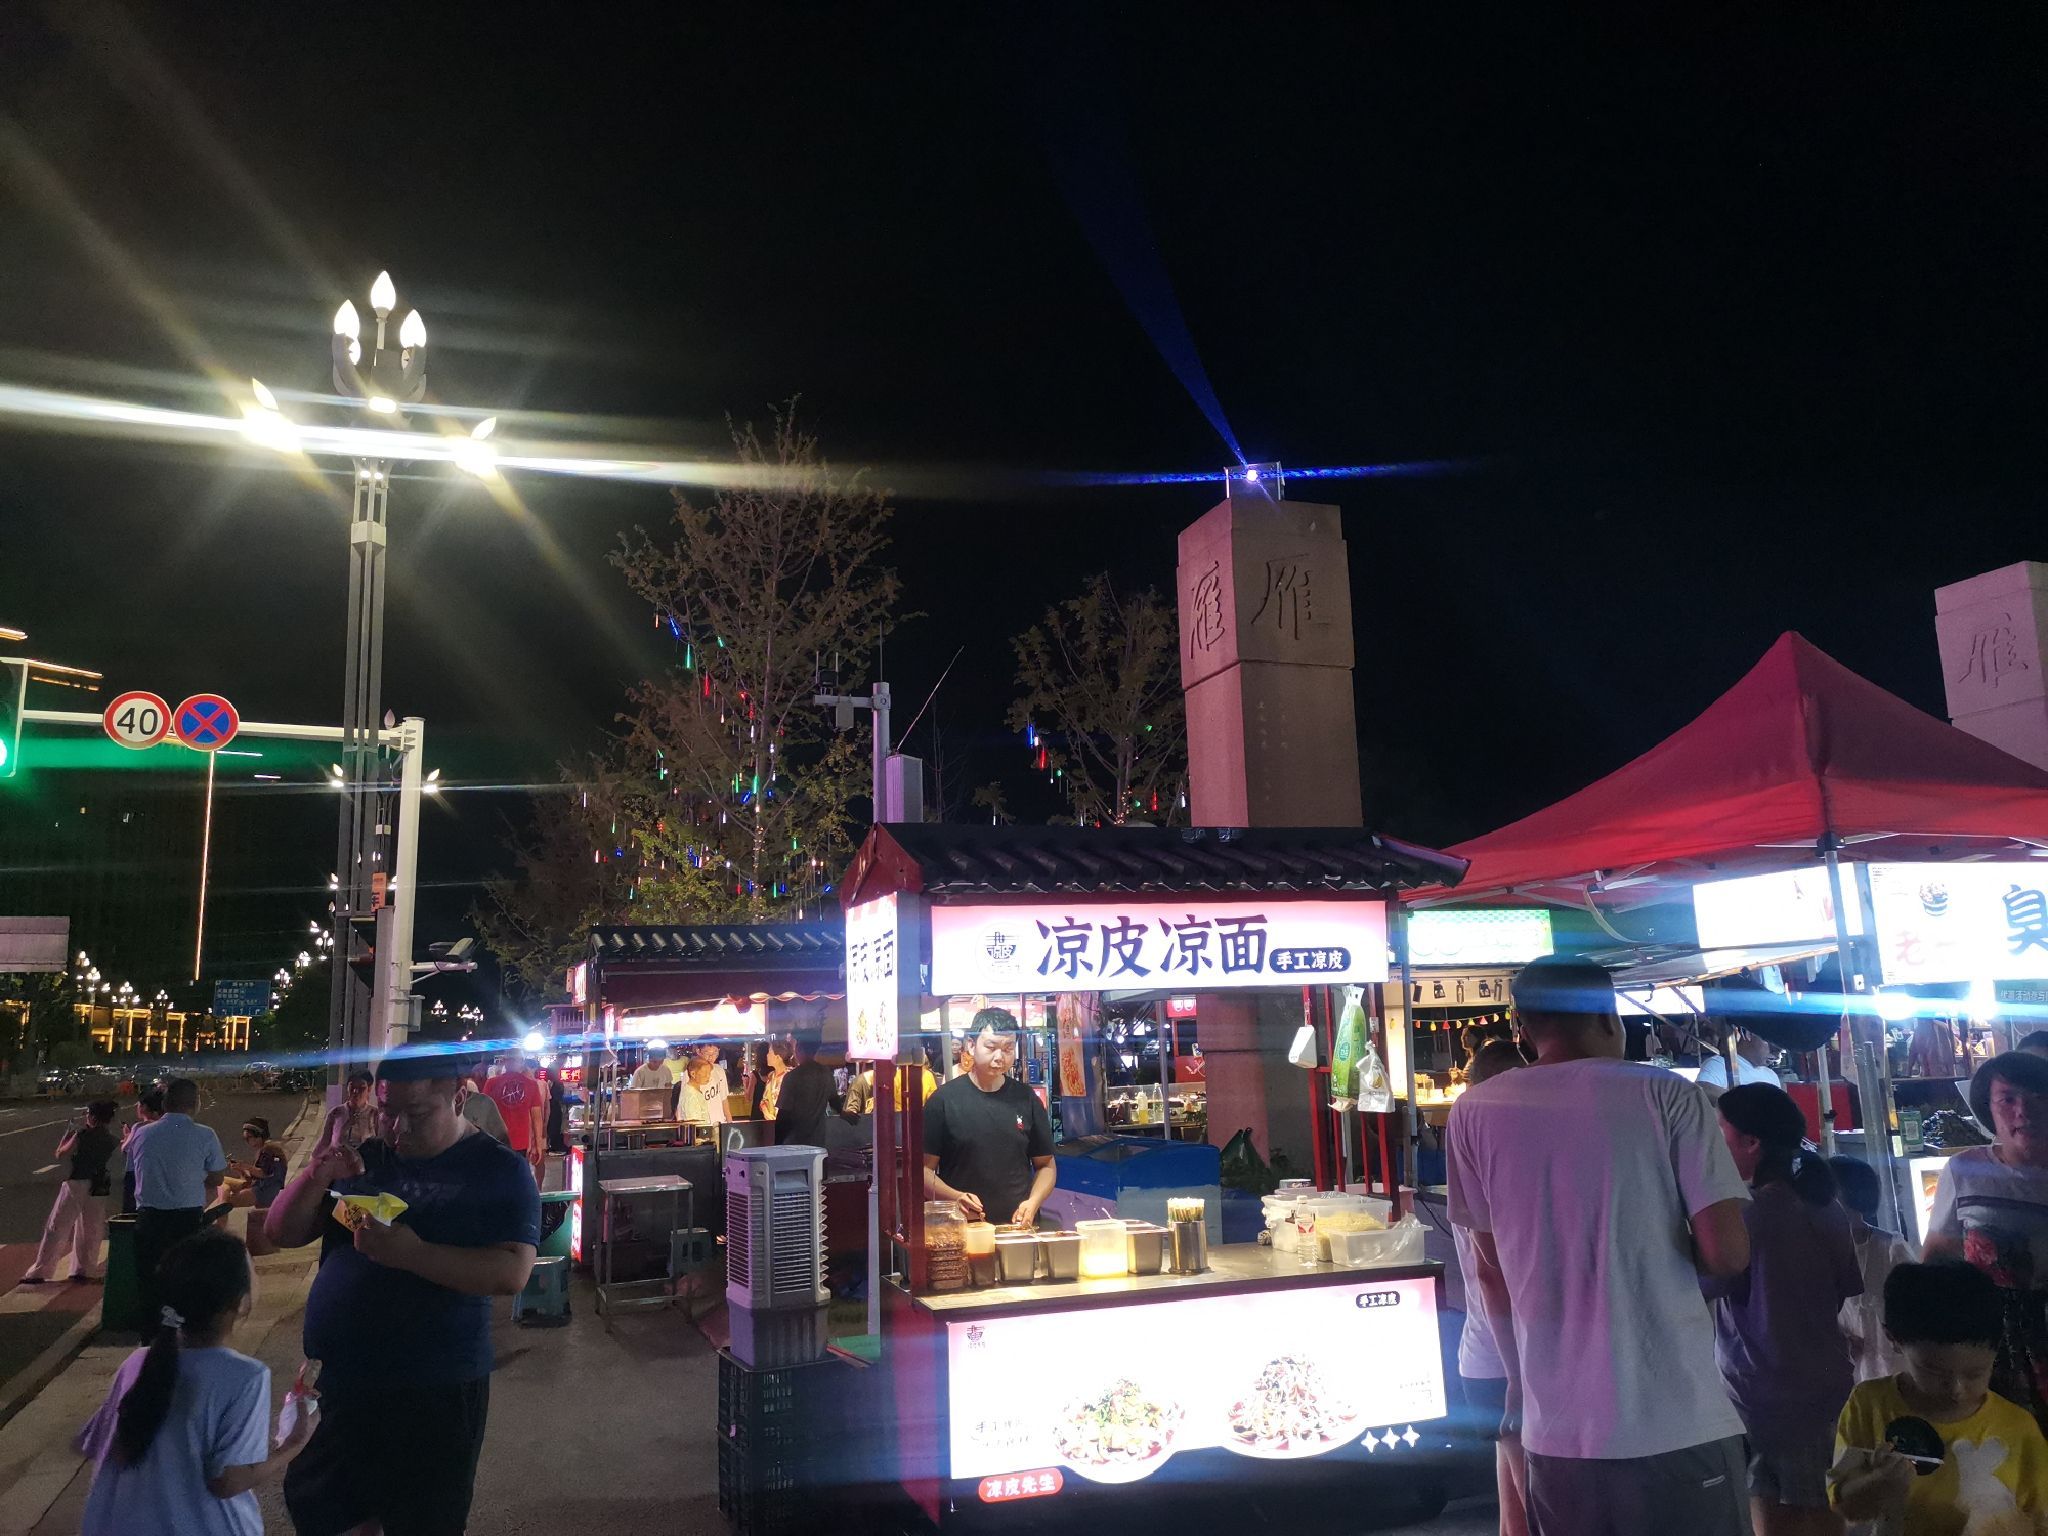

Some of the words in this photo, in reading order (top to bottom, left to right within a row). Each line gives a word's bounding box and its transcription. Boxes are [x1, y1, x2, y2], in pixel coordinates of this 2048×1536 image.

[117, 707, 158, 736] 40
[2002, 884, 2048, 955] 臭
[1036, 914, 1268, 979] 凉皮凉面
[1277, 950, 1343, 970] 手工凉皮
[986, 1474, 1056, 1498] 凉皮先生
